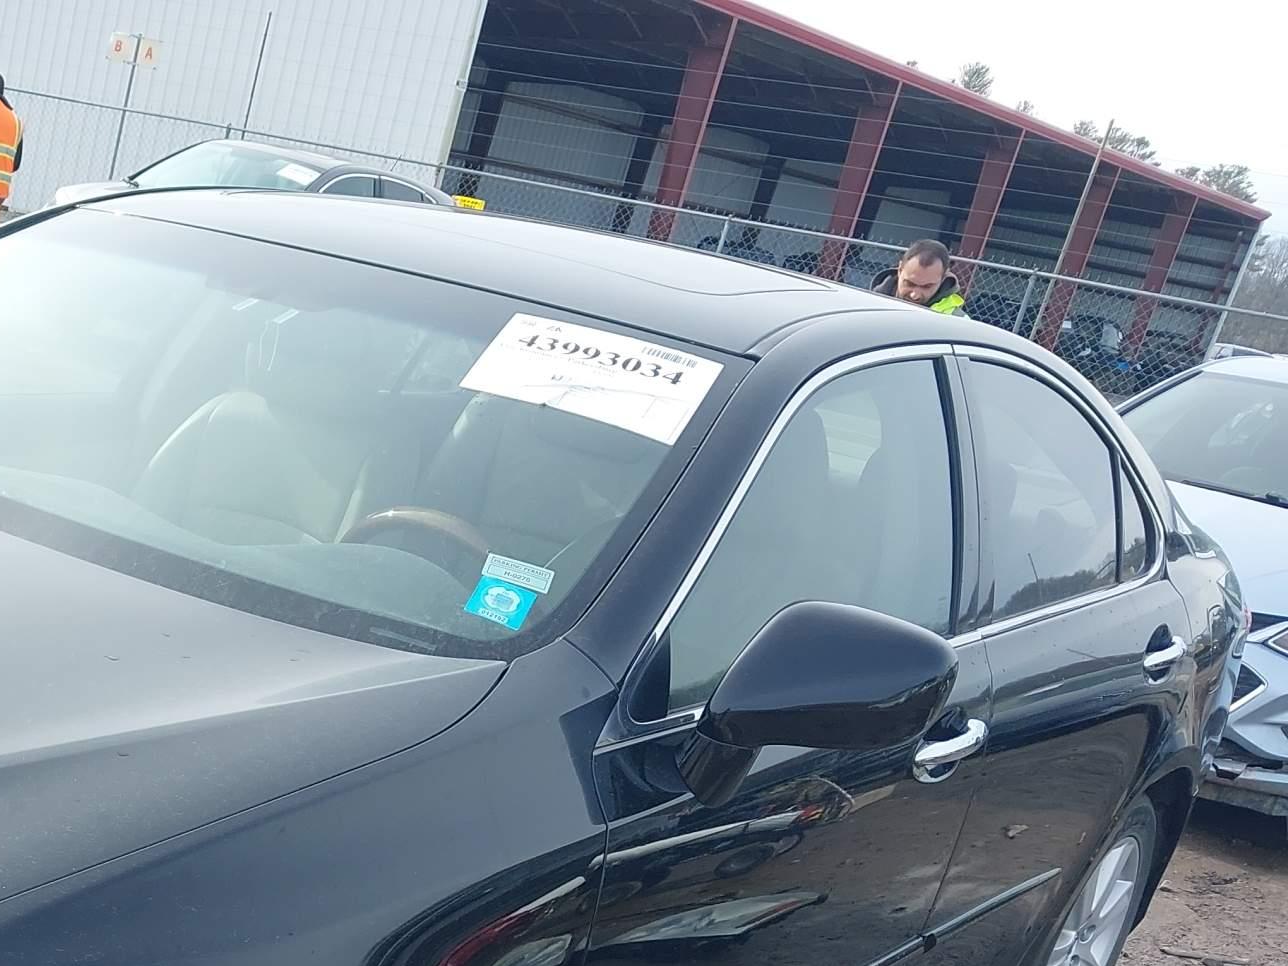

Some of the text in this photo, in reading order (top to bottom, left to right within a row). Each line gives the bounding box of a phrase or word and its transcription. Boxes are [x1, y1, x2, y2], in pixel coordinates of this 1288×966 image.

[114, 39, 122, 52] B
[144, 46, 152, 60] A
[517, 334, 684, 385] 43993034
